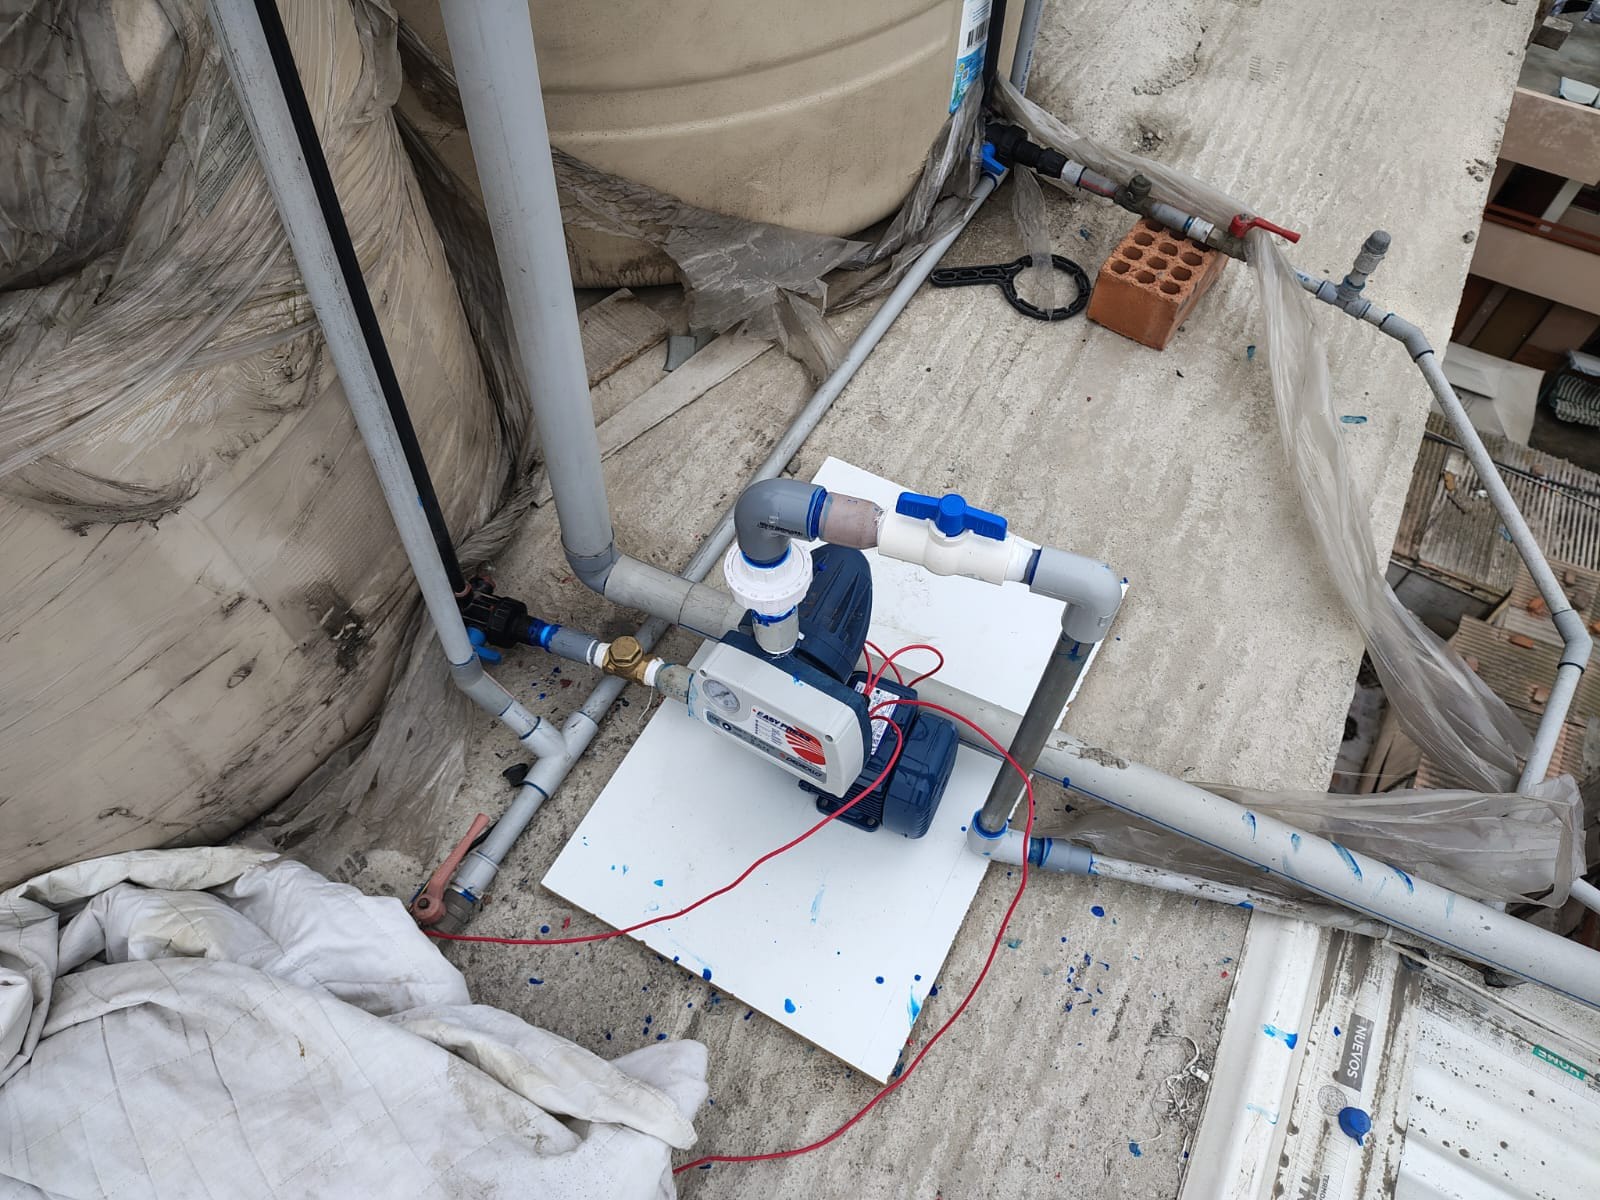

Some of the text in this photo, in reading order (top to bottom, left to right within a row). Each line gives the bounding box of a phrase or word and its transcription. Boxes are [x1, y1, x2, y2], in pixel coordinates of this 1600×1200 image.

[757, 711, 780, 725] EASY
[1346, 1025, 1368, 1079] NUEVOS
[1320, 1174, 1330, 1200] TERMO
